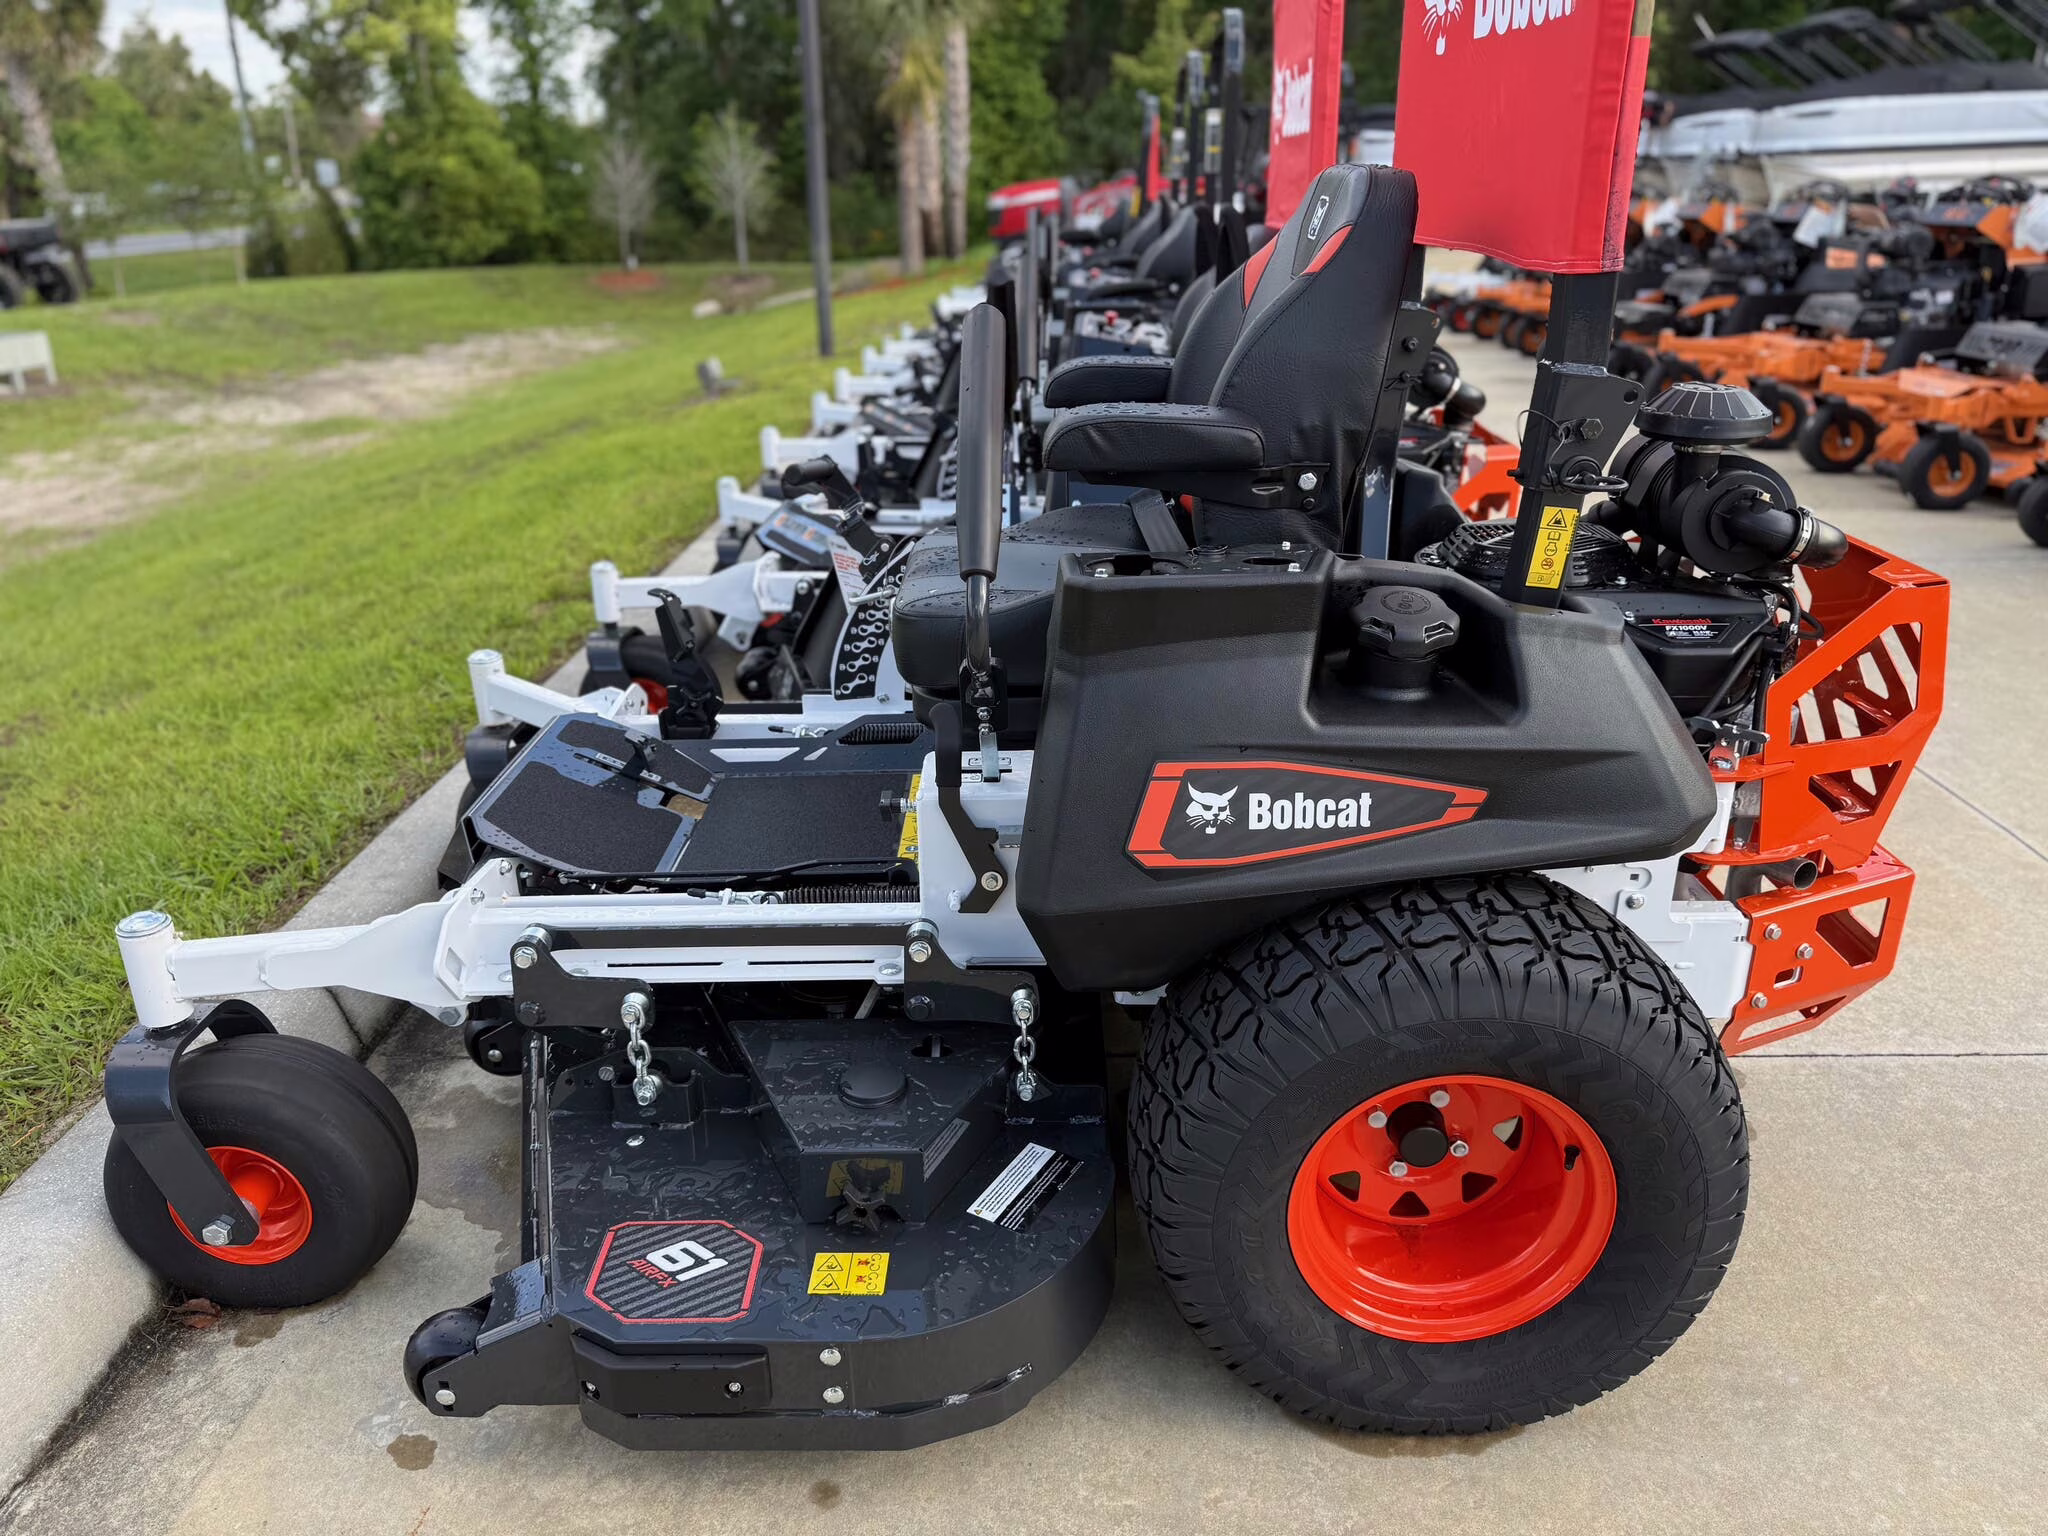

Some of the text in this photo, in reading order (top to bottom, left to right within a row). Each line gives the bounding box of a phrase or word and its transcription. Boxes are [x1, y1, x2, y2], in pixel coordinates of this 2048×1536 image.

[1249, 792, 1372, 830] Bobcat
[626, 1259, 679, 1288] AIRFX
[645, 1240, 729, 1282] 61
